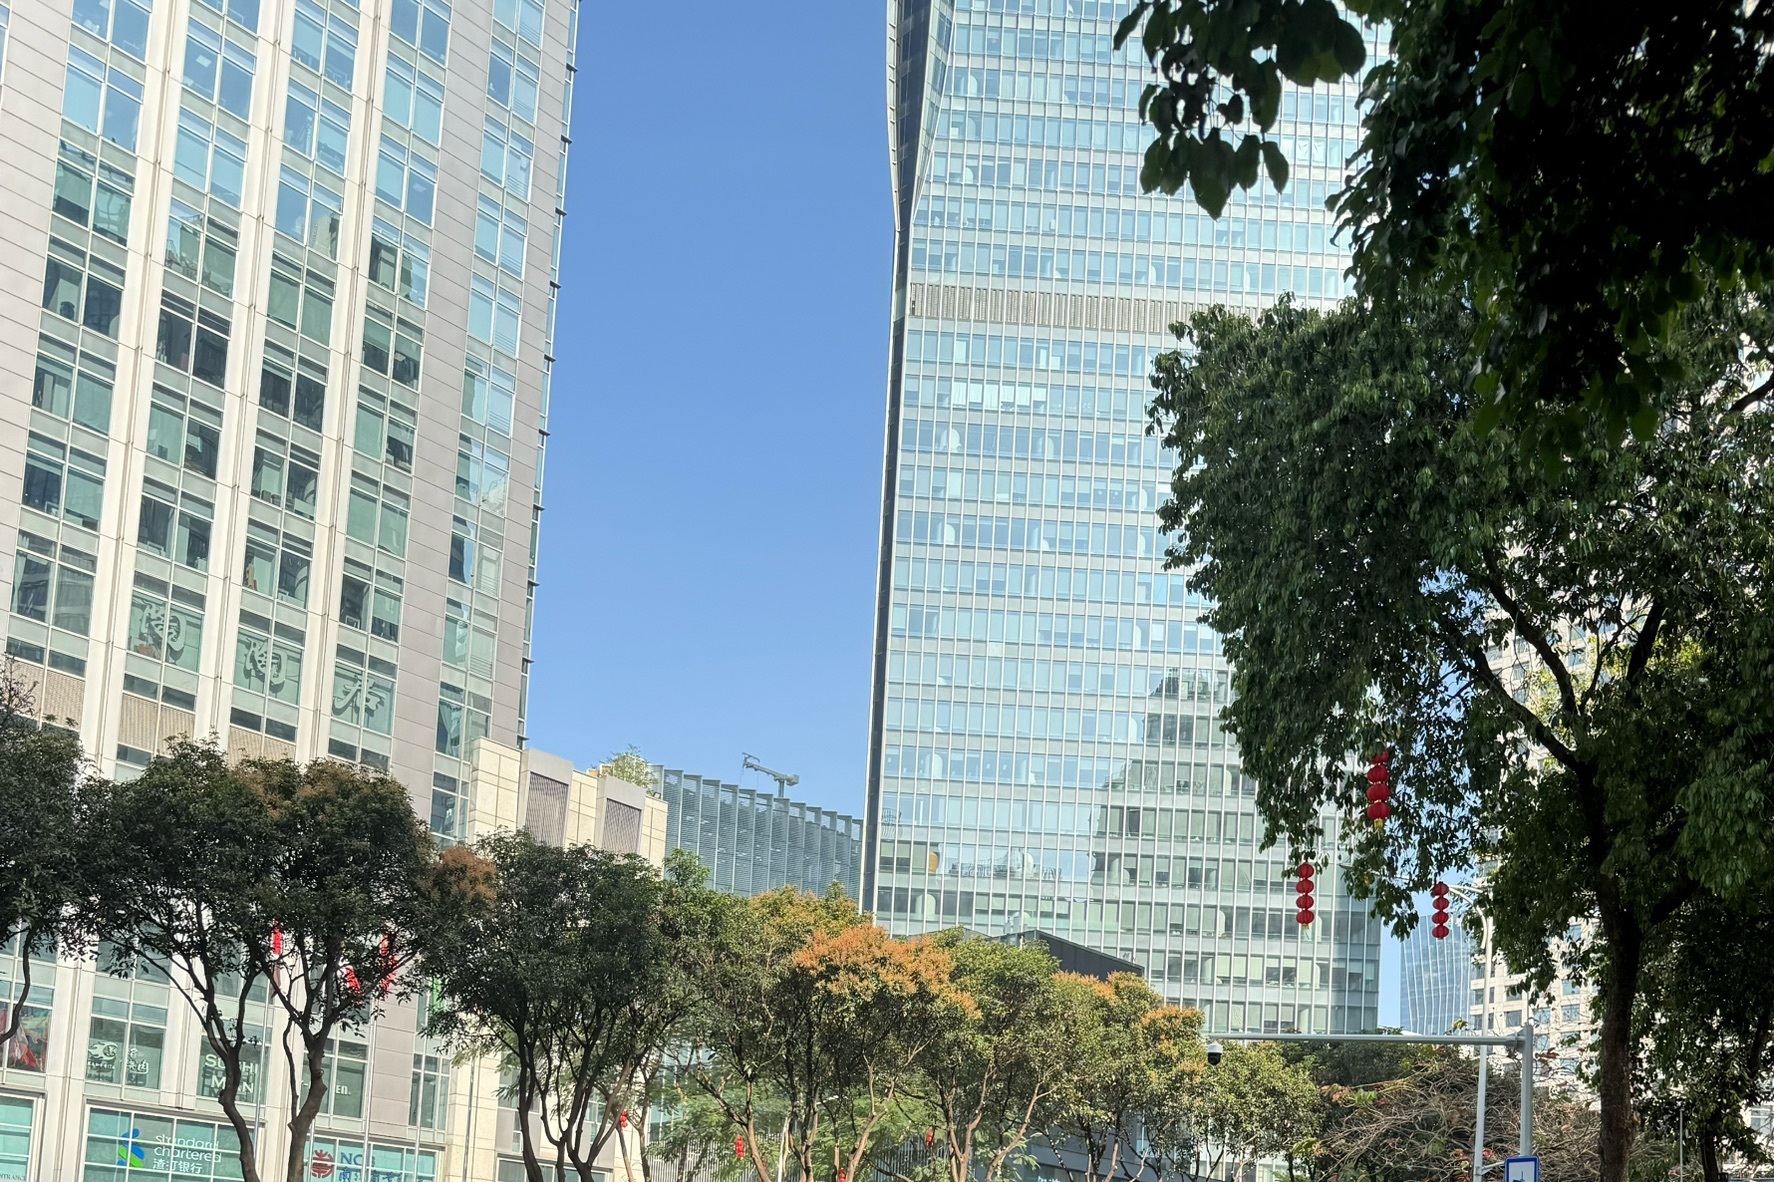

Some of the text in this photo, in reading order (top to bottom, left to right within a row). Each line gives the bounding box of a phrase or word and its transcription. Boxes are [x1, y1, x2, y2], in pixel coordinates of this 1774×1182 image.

[204, 1053, 259, 1074] SUHI
[210, 1074, 254, 1094] MN
[155, 1133, 220, 1150] standard
[154, 1146, 222, 1163] chartered
